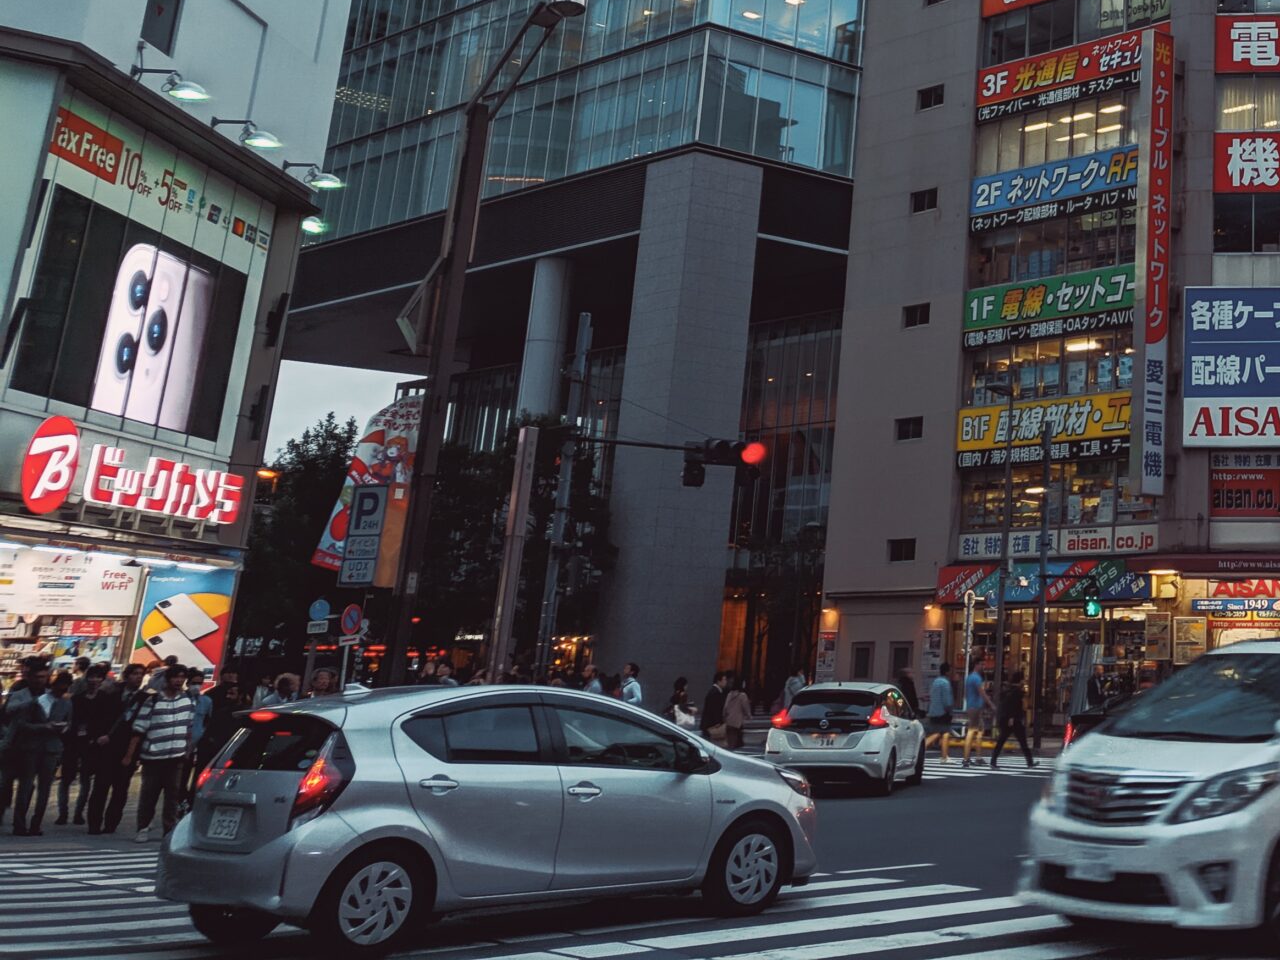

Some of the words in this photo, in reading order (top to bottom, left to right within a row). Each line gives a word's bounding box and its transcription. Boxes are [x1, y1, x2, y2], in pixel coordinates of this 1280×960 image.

[1091, 35, 1138, 57] ネットワーク
[982, 70, 1009, 97] 3F
[51, 116, 81, 152] Tax
[80, 130, 116, 175] Free
[121, 147, 142, 190] 10
[137, 181, 153, 197] OFF
[158, 169, 175, 206] 5
[168, 198, 183, 214] OFF
[975, 182, 1003, 209] 2F
[969, 294, 996, 322] 1F
[961, 415, 991, 441] B1F
[1143, 359, 1164, 478] 愛三電機
[82, 443, 246, 525] ビックカメラ
[354, 491, 380, 530] P
[361, 520, 379, 531] 24H
[962, 537, 980, 556] 各社
[1012, 535, 1030, 553] 在庫
[100, 581, 129, 591] Wi-Fi
[102, 569, 128, 580] Free
[1244, 600, 1268, 610] 1949
